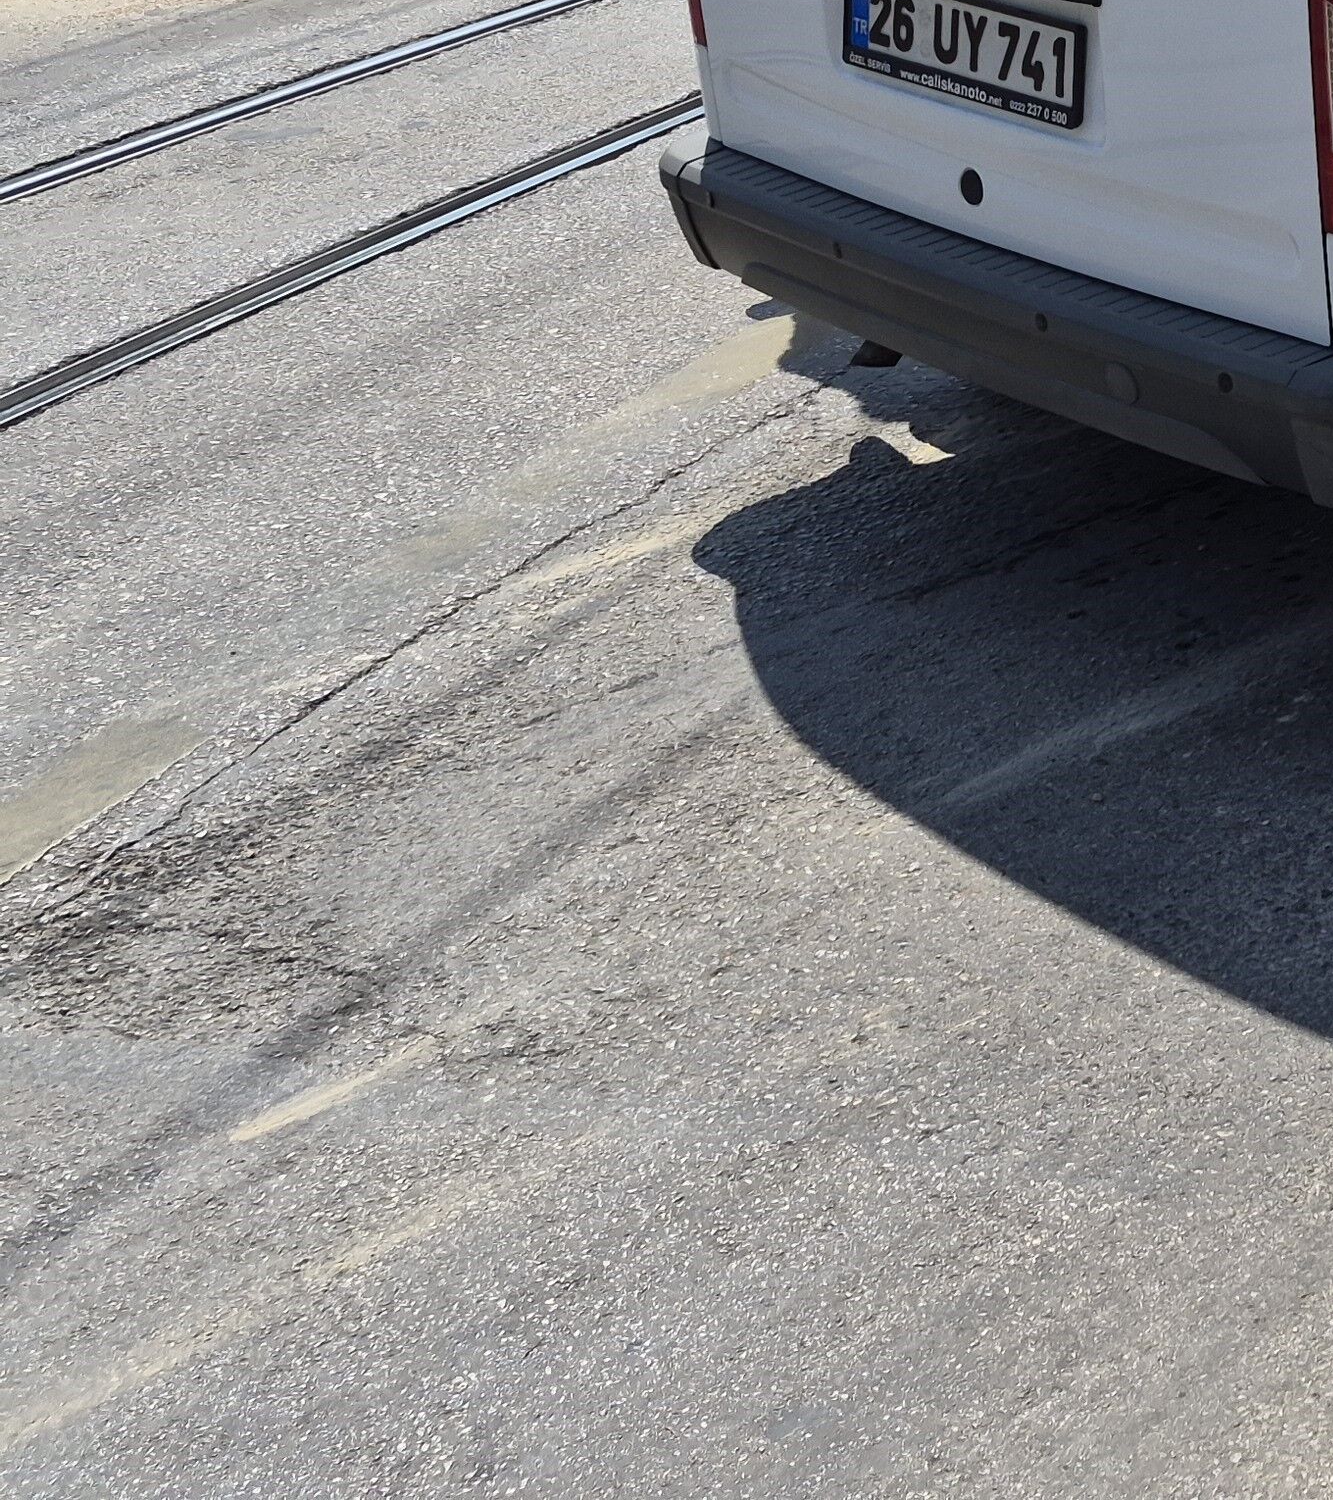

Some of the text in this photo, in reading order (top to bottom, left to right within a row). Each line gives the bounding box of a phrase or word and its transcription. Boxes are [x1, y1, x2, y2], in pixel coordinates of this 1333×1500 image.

[853, 17, 868, 35] TR
[933, 3, 988, 72] UY
[998, 22, 1067, 98] 741
[1027, 102, 1043, 117] 237
[1044, 108, 1050, 120] 0
[1051, 110, 1068, 125] 500
